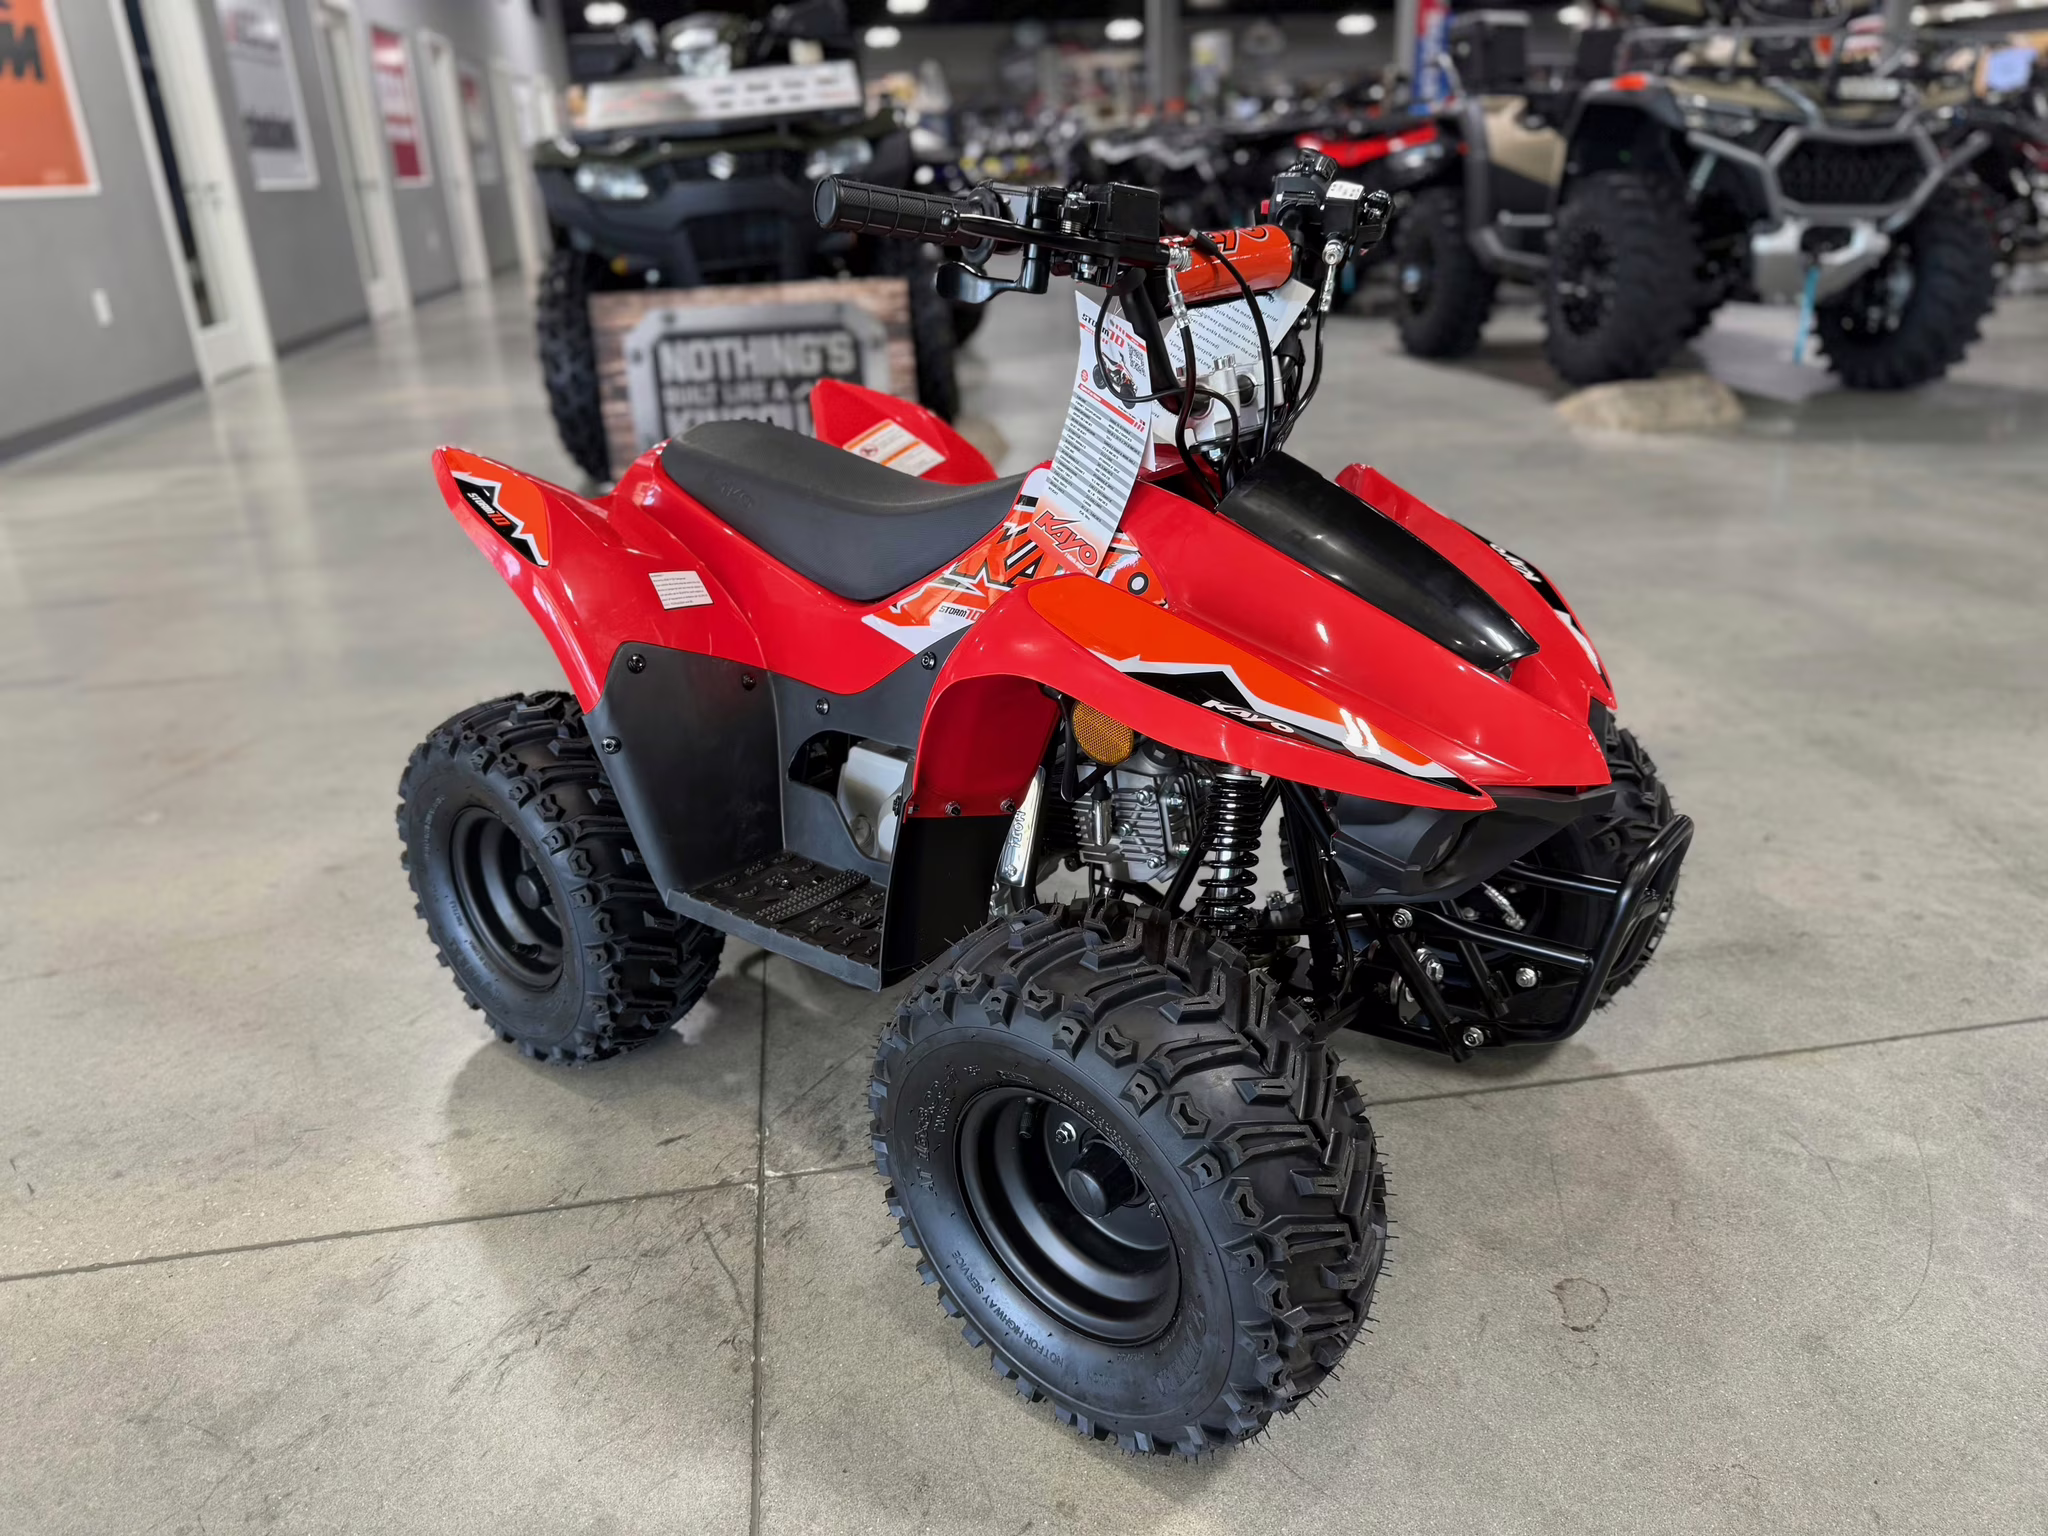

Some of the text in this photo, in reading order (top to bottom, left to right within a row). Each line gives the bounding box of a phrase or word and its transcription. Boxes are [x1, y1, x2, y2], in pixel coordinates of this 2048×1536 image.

[659, 334, 855, 380] NOTHING'S
[1034, 509, 1099, 567] KAYO
[1201, 699, 1294, 733] KAYO
[951, 1250, 985, 1294] SERVICE
[982, 1293, 1025, 1338] HIGHWAY
